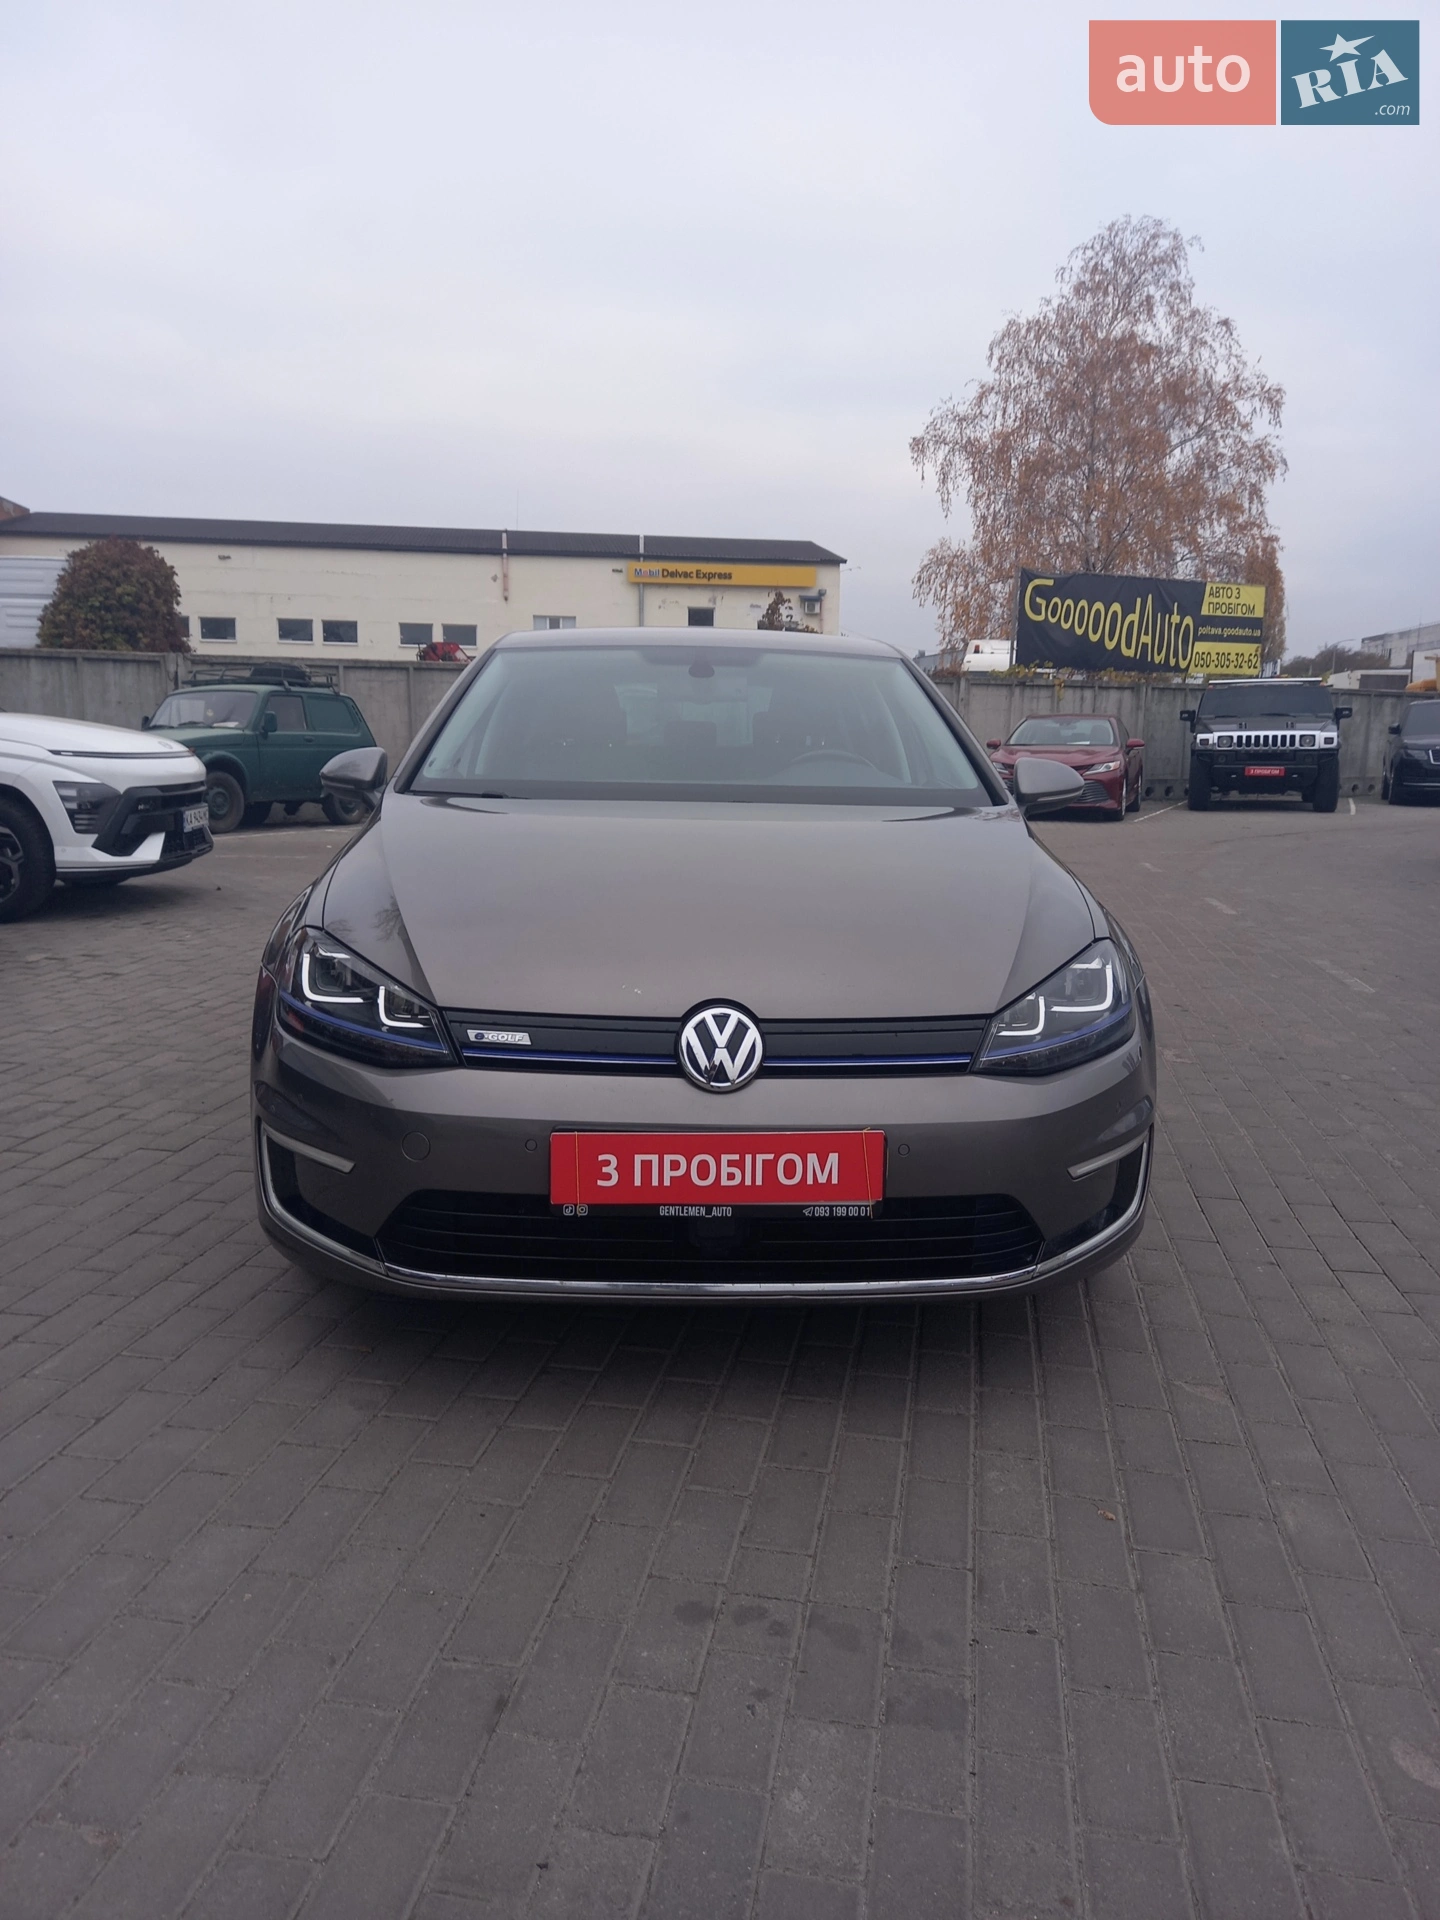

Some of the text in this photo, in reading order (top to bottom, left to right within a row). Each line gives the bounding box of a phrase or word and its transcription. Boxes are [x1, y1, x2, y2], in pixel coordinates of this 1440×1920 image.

[634, 568, 733, 581] Mobil Delvac Express
[1208, 586, 1233, 599] АВТО
[1207, 601, 1256, 616] ПРОБІГОМ
[1197, 625, 1261, 637] poltava.goodauto.ua
[1194, 651, 1259, 669] 050-305-32-62
[633, 1152, 839, 1187] ПРОБІГОМ
[659, 1205, 732, 1217] GENTLEMEN_AUTO
[814, 1206, 870, 1217] 093 199 00 01
